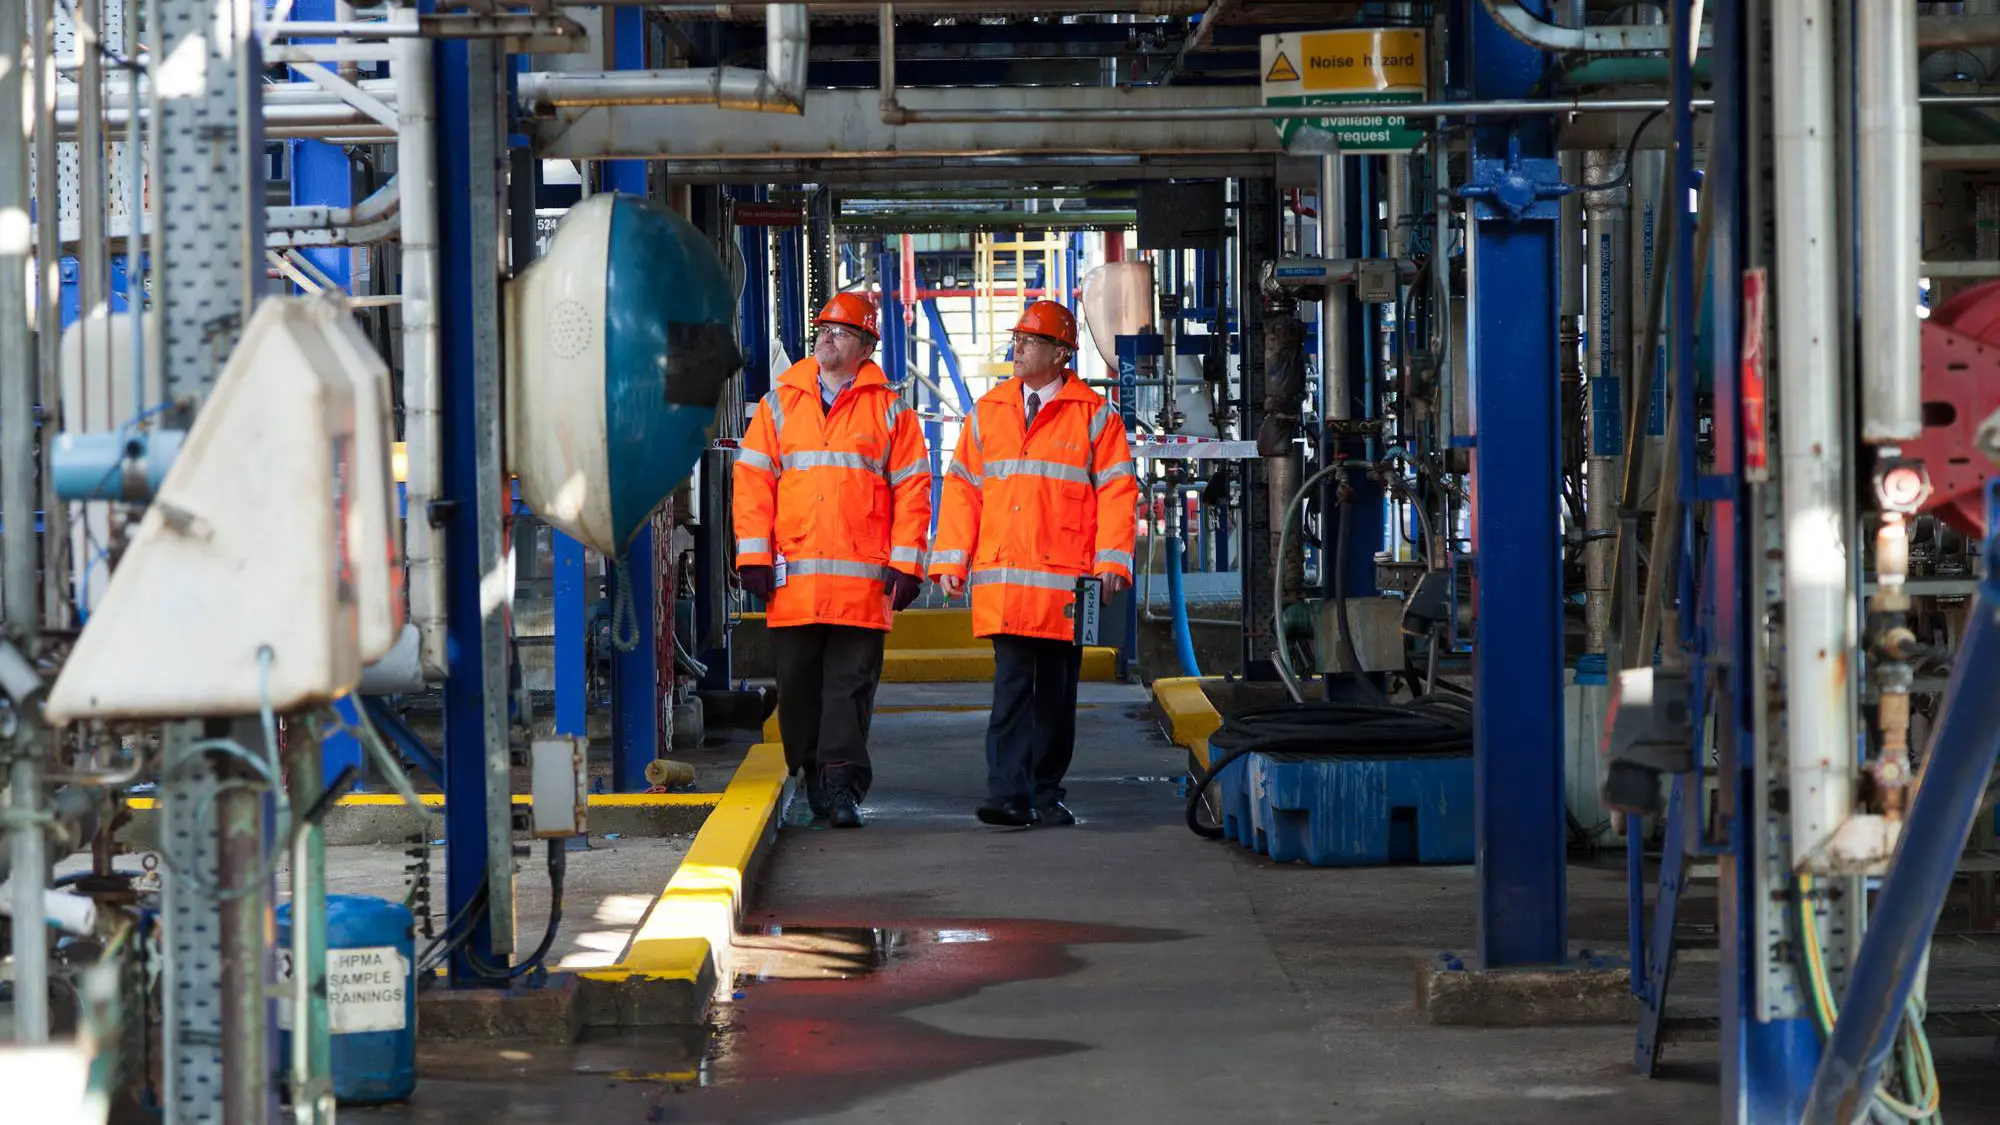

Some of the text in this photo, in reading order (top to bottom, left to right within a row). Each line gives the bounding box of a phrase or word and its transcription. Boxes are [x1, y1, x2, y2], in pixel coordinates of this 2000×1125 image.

[1311, 54, 1414, 69] Noise hzard
[1387, 116, 1405, 126] on
[1338, 132, 1391, 144] request
[340, 953, 383, 968] HPMA
[330, 971, 391, 987] SAMPLE
[330, 988, 403, 1005] RAININGS
